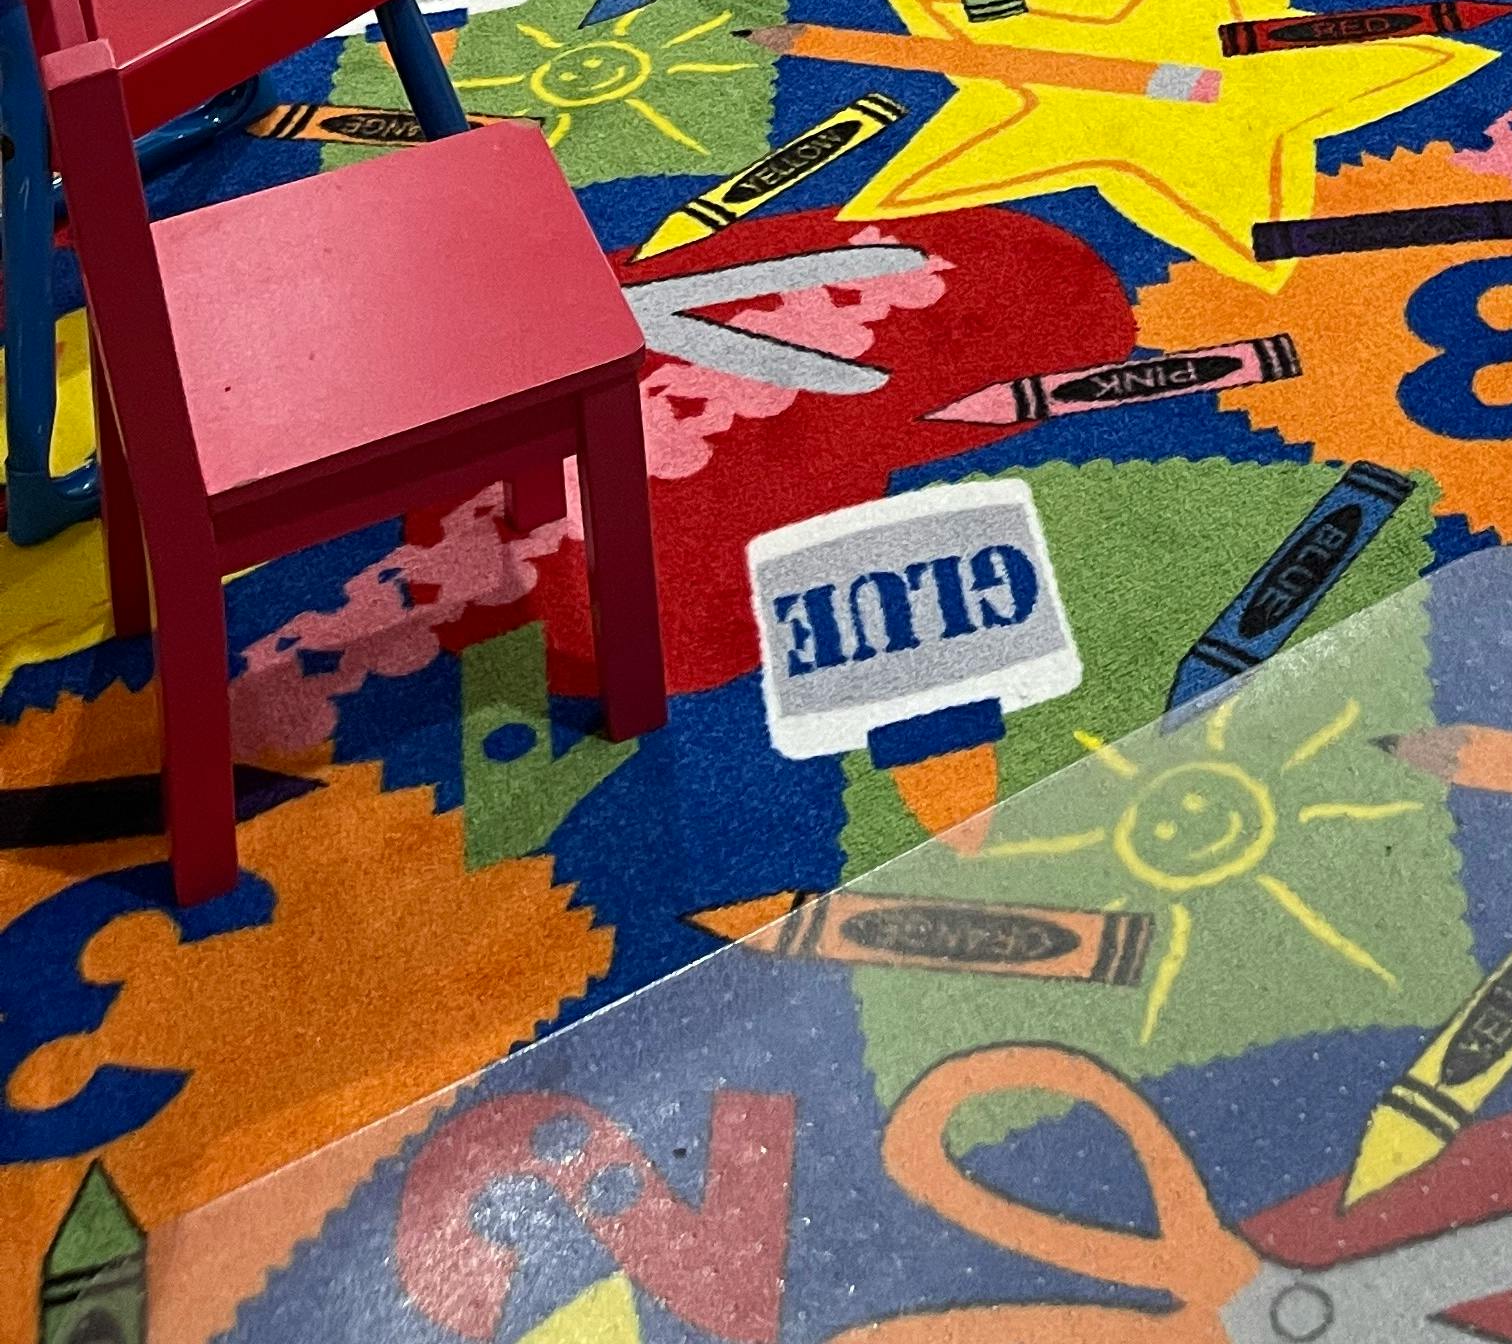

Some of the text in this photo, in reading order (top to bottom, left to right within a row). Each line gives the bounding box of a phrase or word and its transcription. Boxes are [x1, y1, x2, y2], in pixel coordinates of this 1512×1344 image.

[1311, 18, 1390, 40] RED
[343, 117, 420, 138] ANGE
[1091, 362, 1197, 397] PINK
[1256, 525, 1348, 626] BLUE
[775, 543, 1041, 677] GLUE
[397, 1092, 793, 1344] 2
